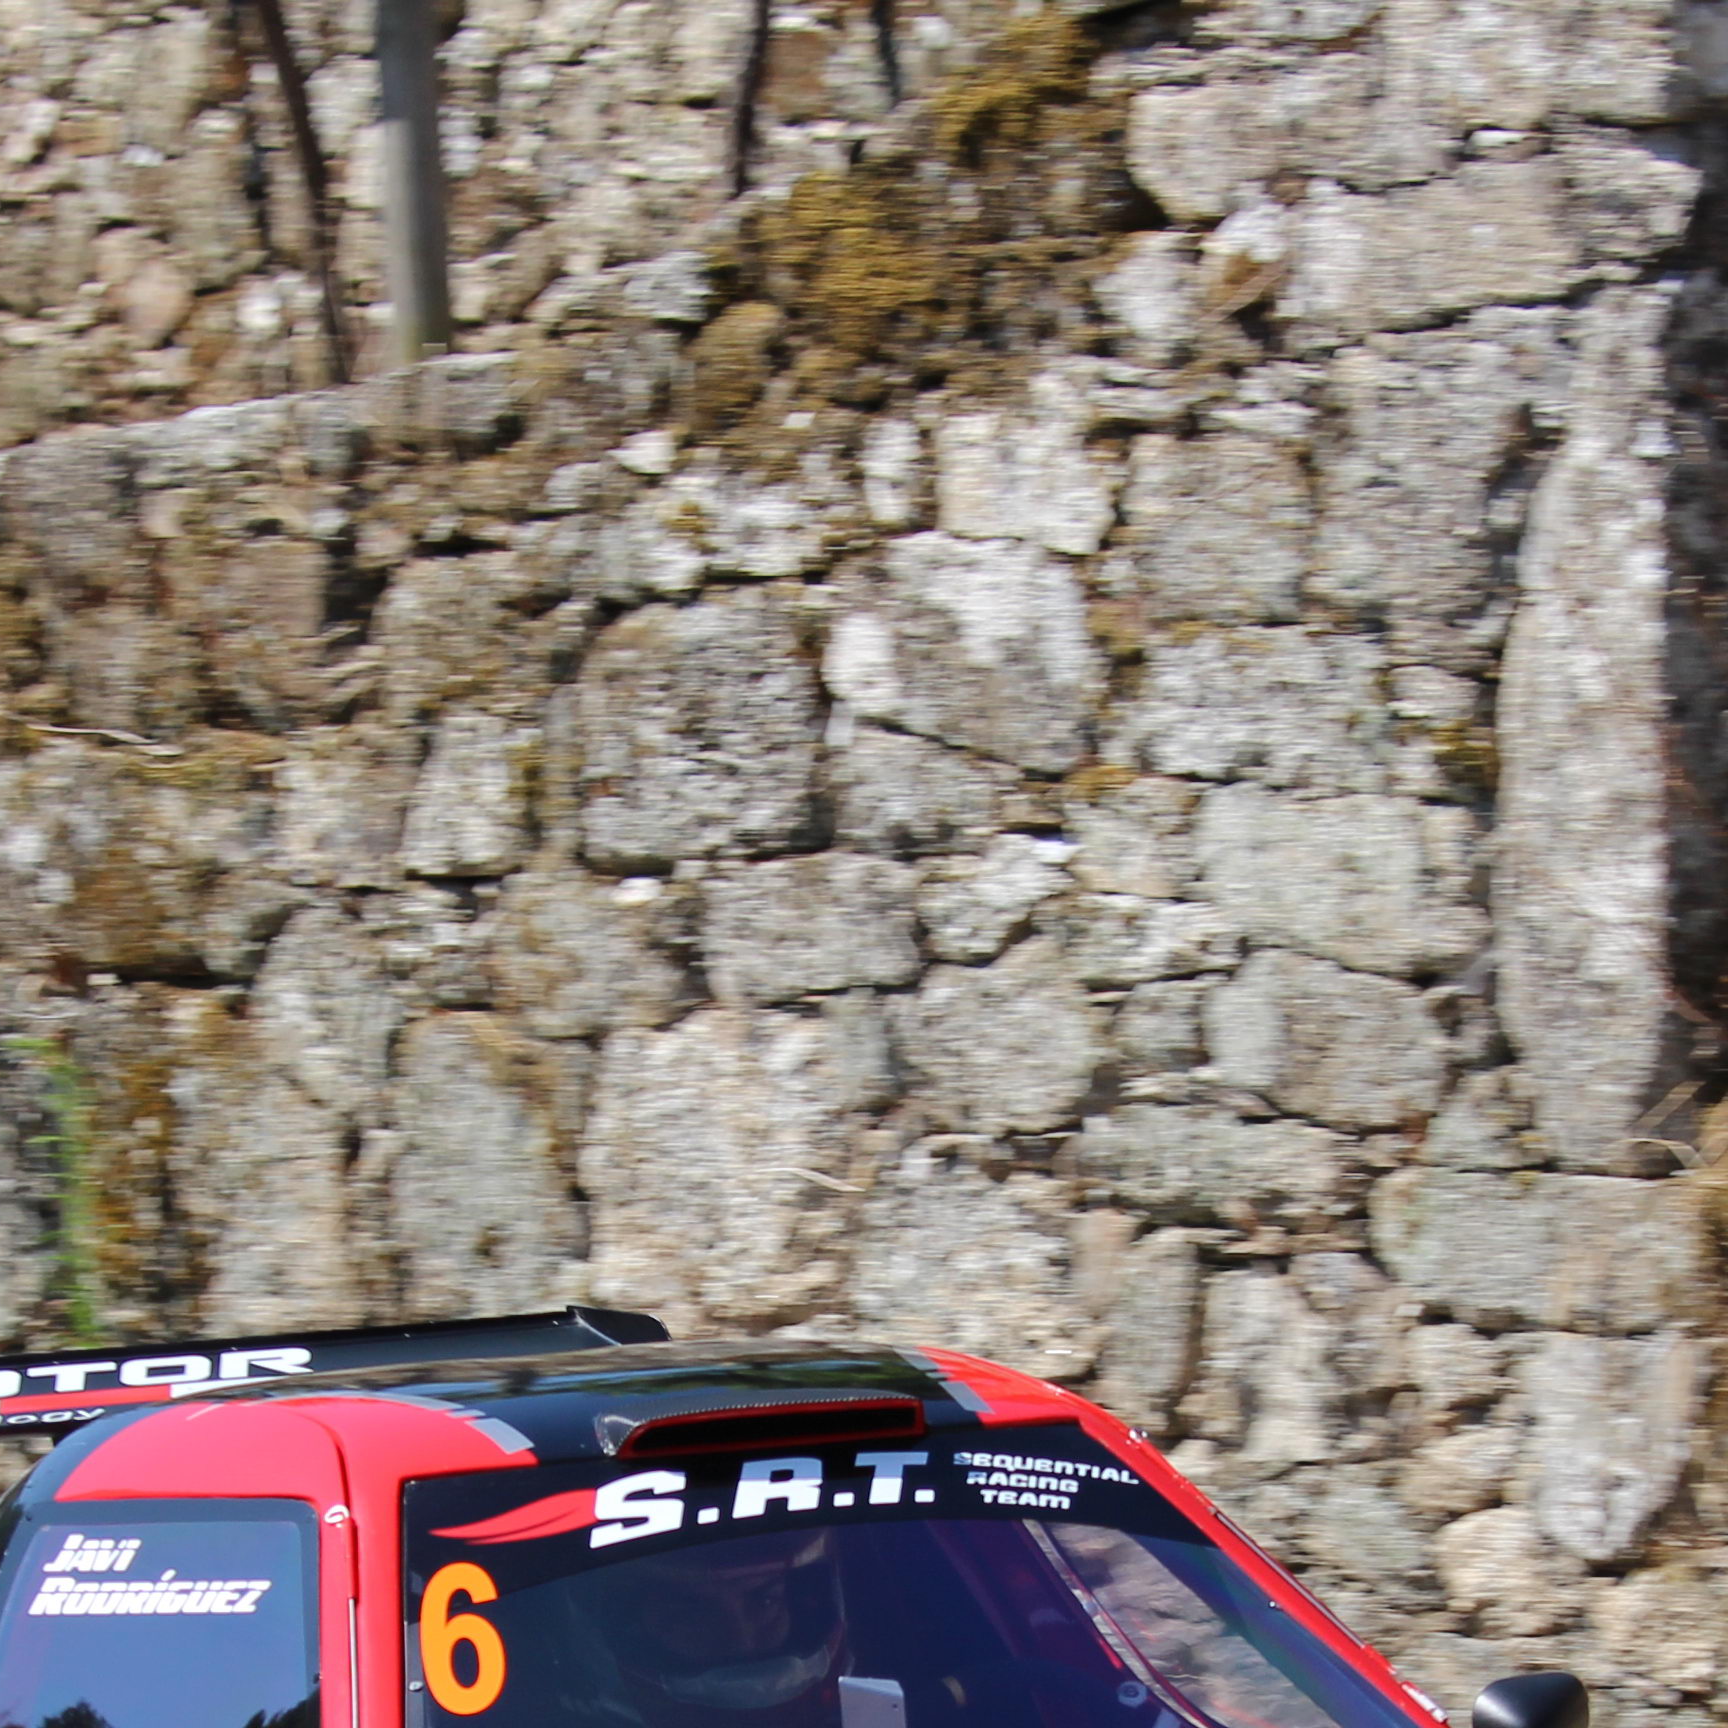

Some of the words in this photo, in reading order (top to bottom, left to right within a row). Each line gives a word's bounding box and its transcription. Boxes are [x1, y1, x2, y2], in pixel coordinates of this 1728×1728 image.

[953, 1452, 1140, 1485] SEQUENTIAL
[966, 1471, 1079, 1493] RACING
[980, 1489, 1071, 1510] TEAM
[419, 1561, 507, 1716] 6
